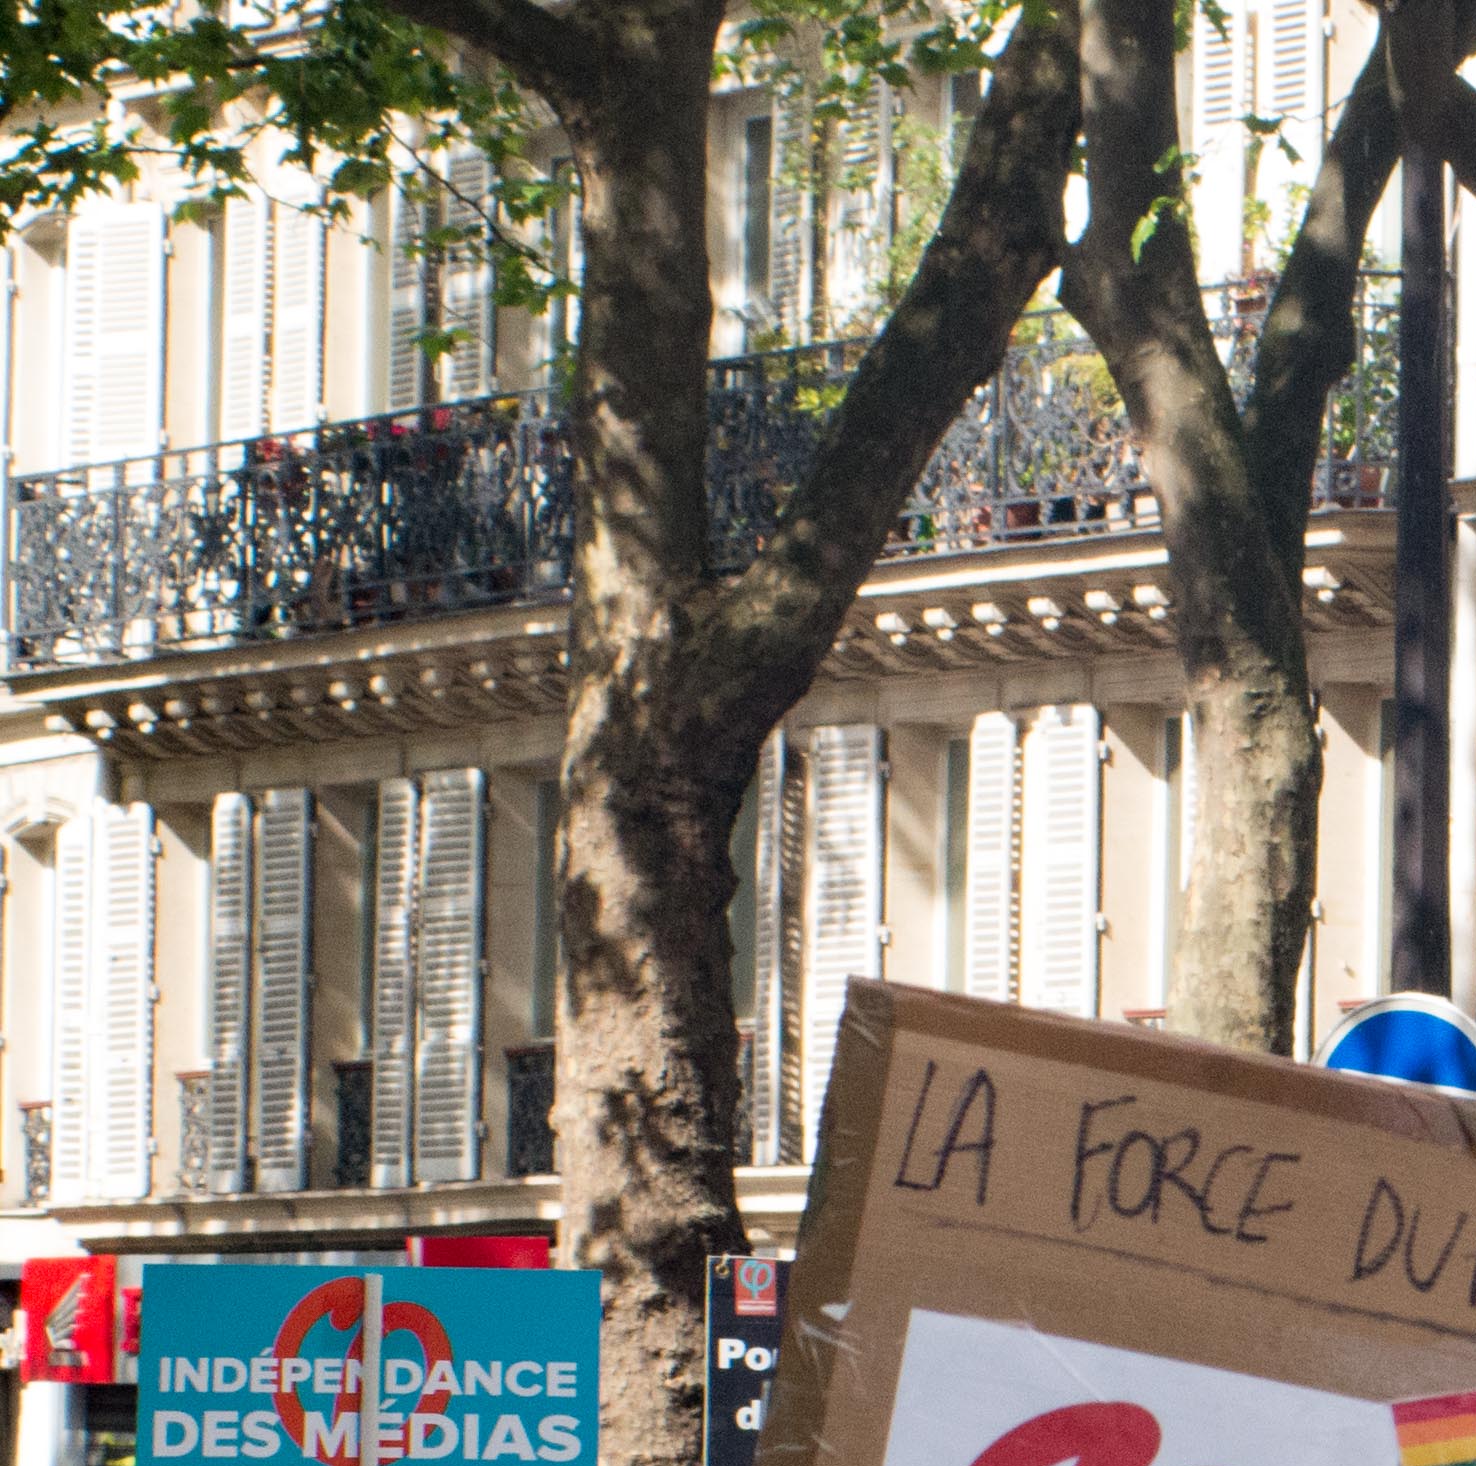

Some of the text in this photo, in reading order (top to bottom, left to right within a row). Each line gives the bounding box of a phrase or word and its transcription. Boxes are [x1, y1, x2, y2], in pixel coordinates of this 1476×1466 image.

[893, 1060, 997, 1207] LA
[1070, 1096, 1302, 1243] FORCE
[1349, 1176, 1468, 1293] DU
[152, 1399, 582, 1462] DES MÉDIAS
